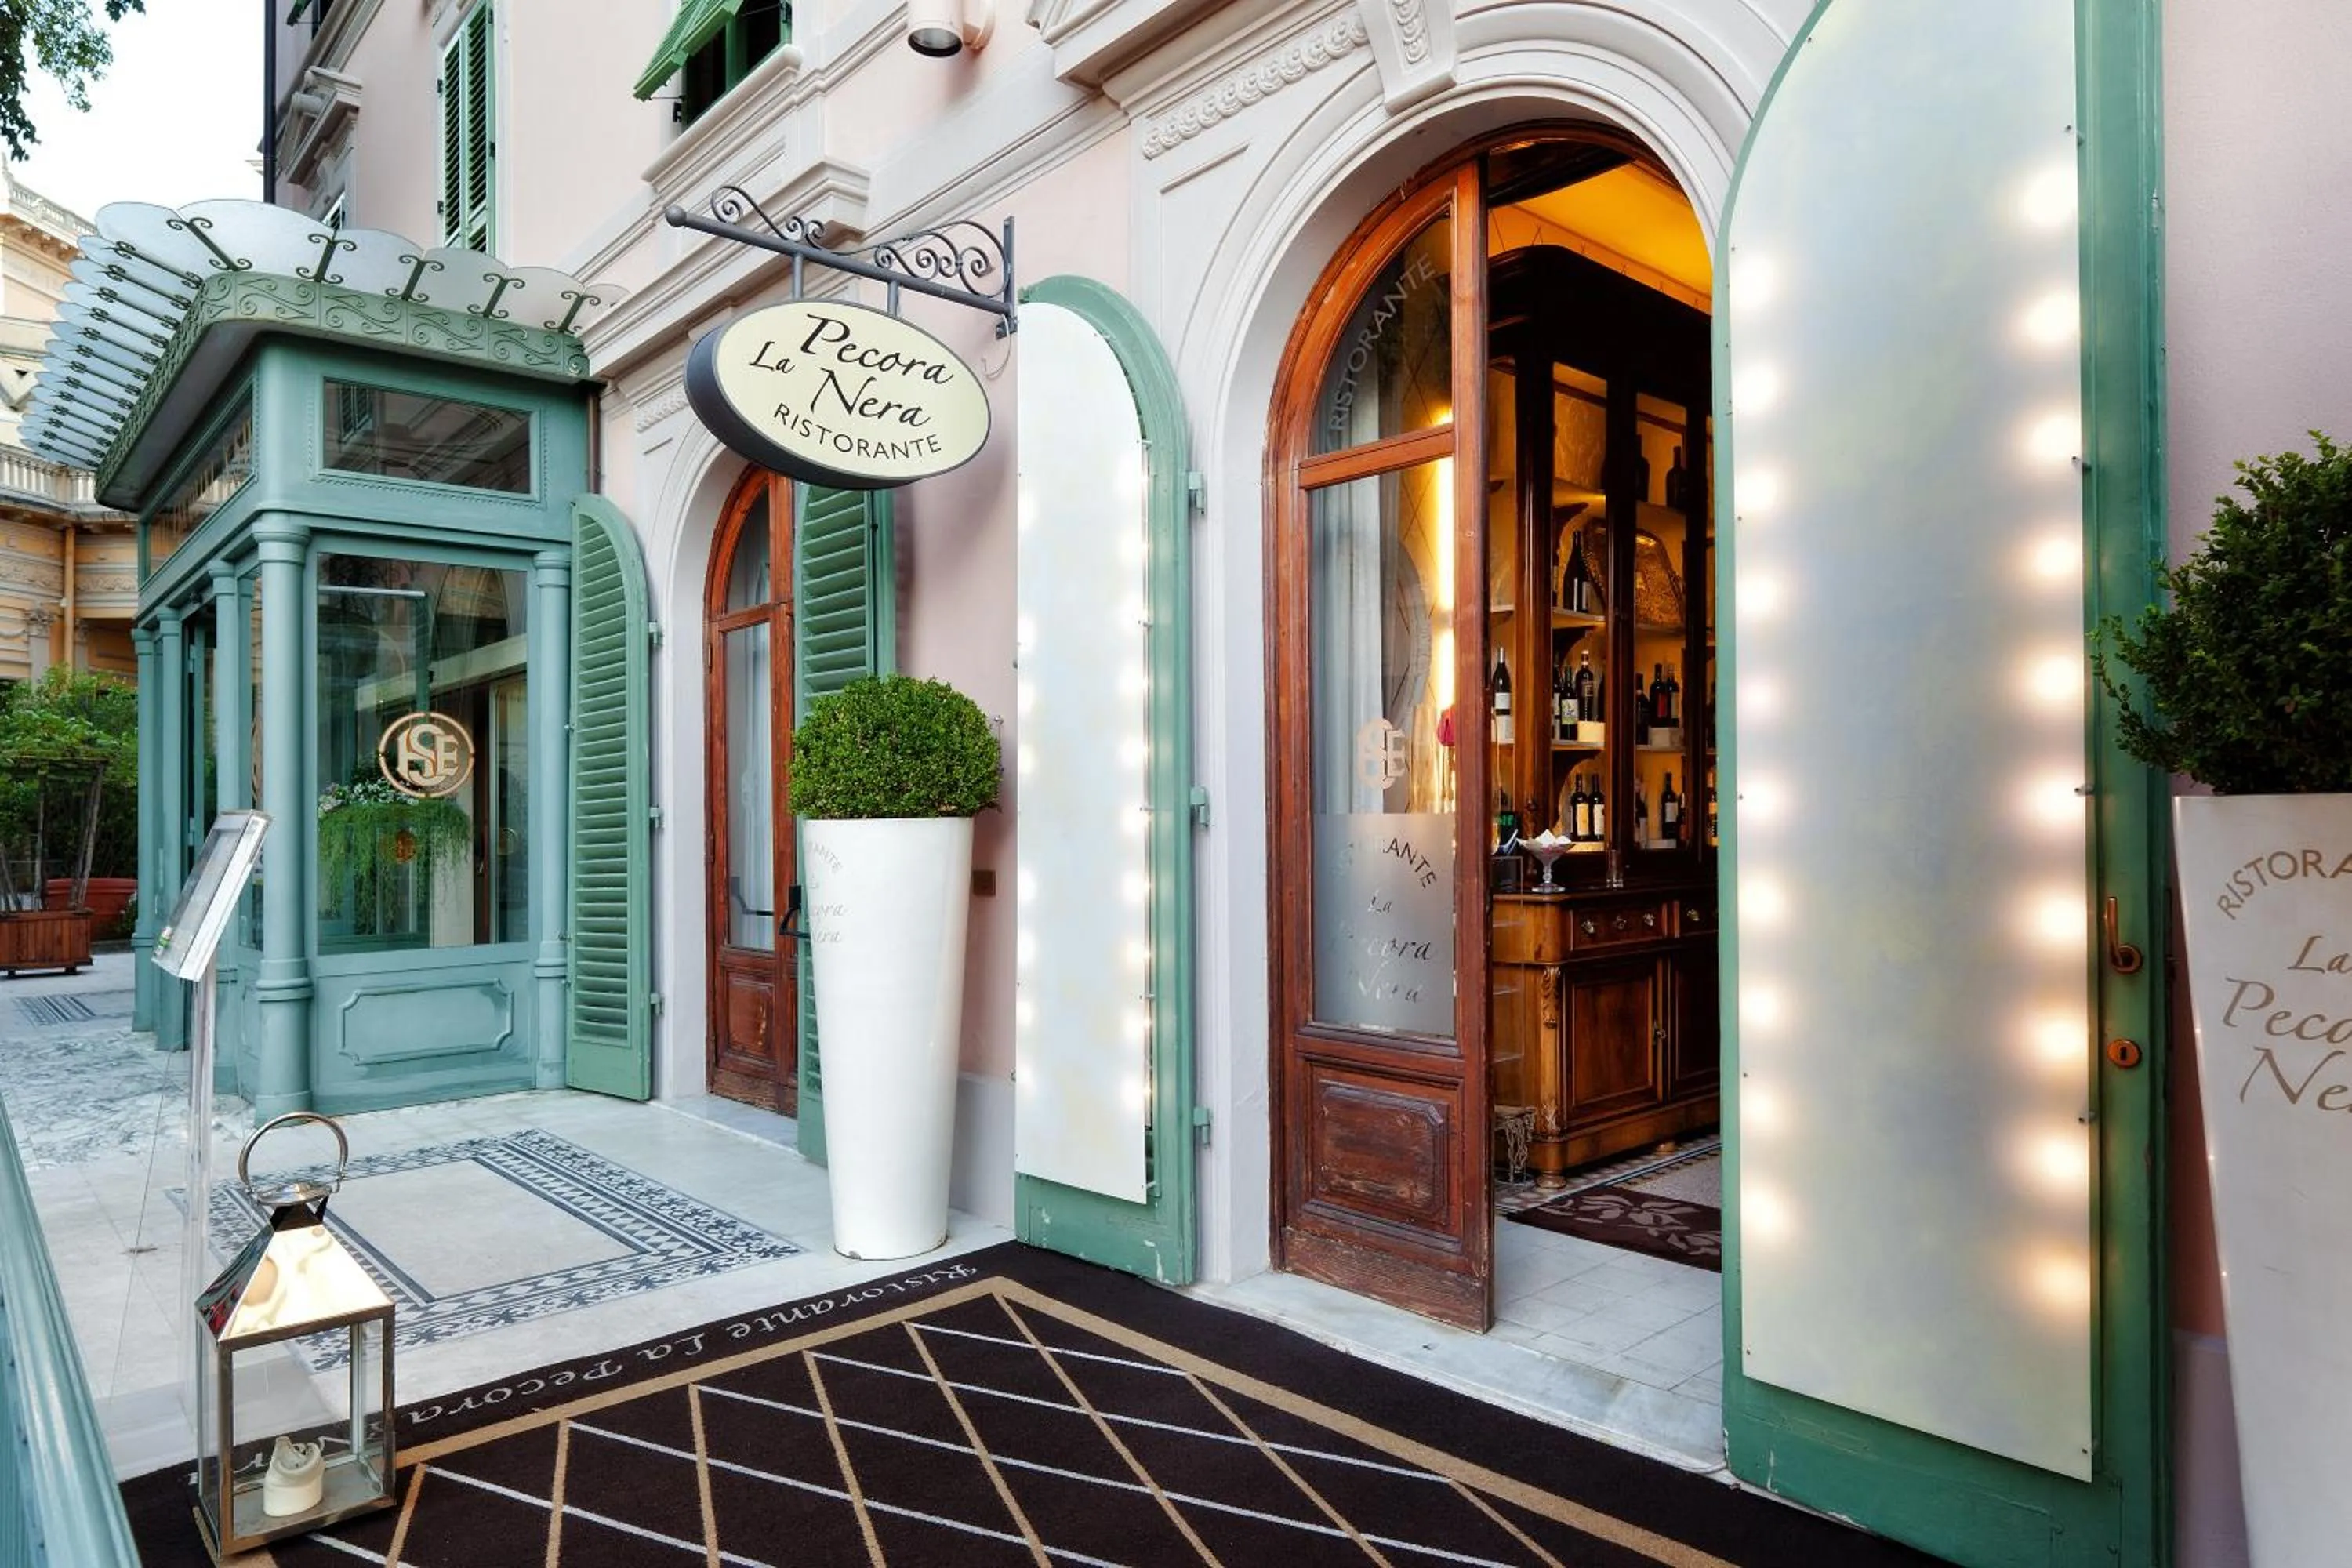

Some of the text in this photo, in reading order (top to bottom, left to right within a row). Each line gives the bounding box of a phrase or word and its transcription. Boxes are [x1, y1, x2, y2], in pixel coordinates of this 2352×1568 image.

[749, 313, 954, 385] La Pecora
[1330, 252, 1436, 431] RISTORANTE
[809, 366, 931, 428] Nera
[773, 402, 942, 461] RISTORANTE
[2287, 935, 2352, 974] La
[403, 1263, 978, 1425] Ristorante La Pecora
